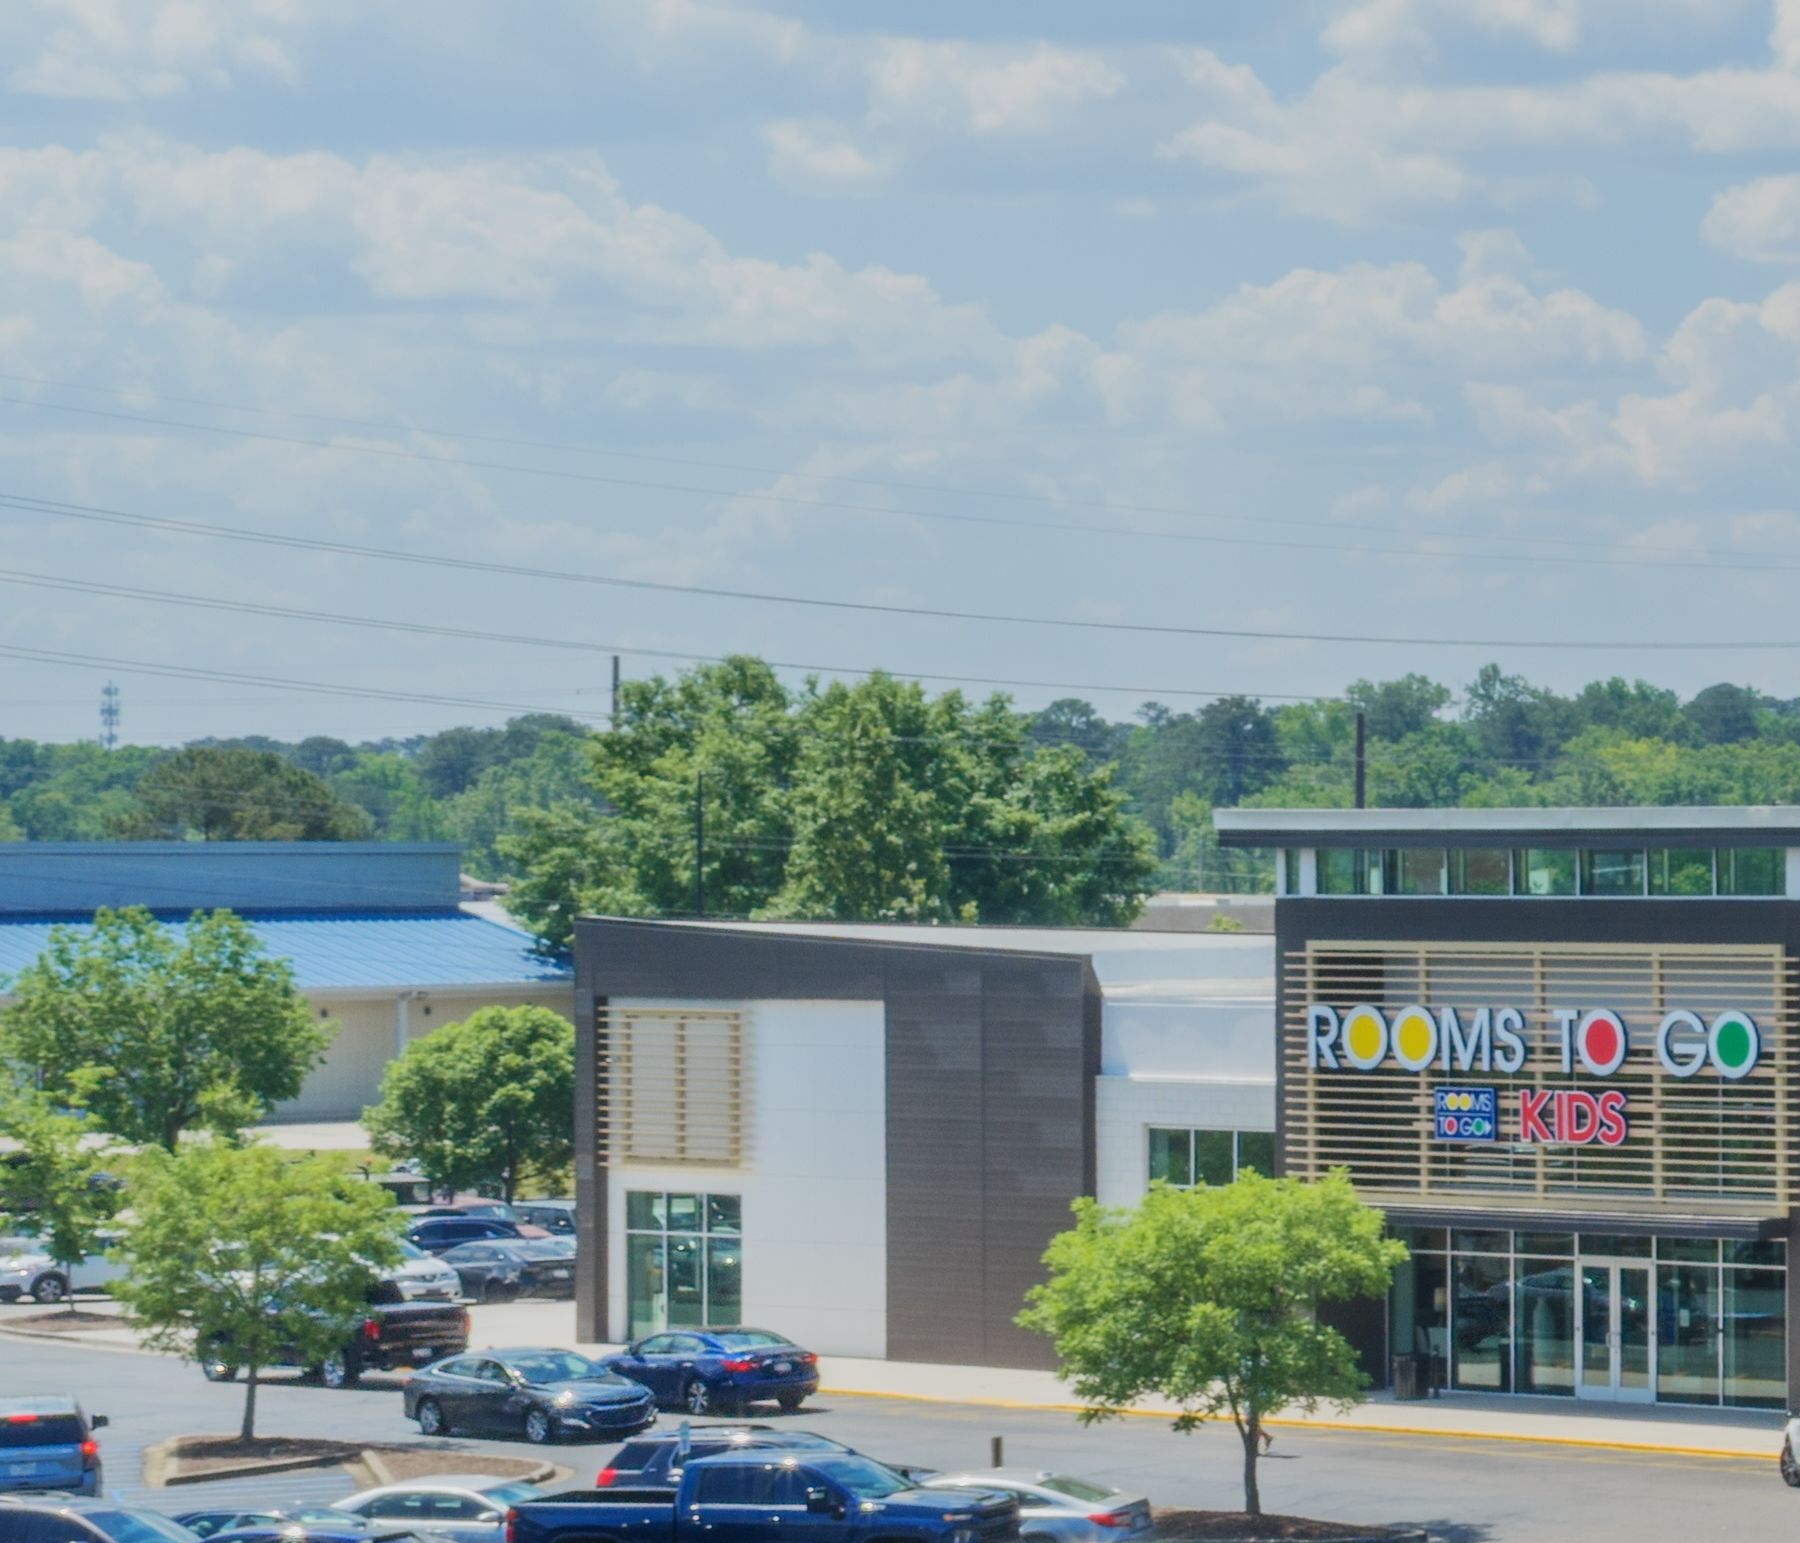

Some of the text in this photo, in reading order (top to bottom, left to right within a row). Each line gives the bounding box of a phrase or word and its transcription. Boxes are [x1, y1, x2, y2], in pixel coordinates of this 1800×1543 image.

[1307, 1005, 1761, 1079] ROOMS TO GO
[1438, 1092, 1492, 1111] ROOMS
[1520, 1089, 1628, 1146] KIDS
[1439, 1116, 1486, 1136] TO GO
